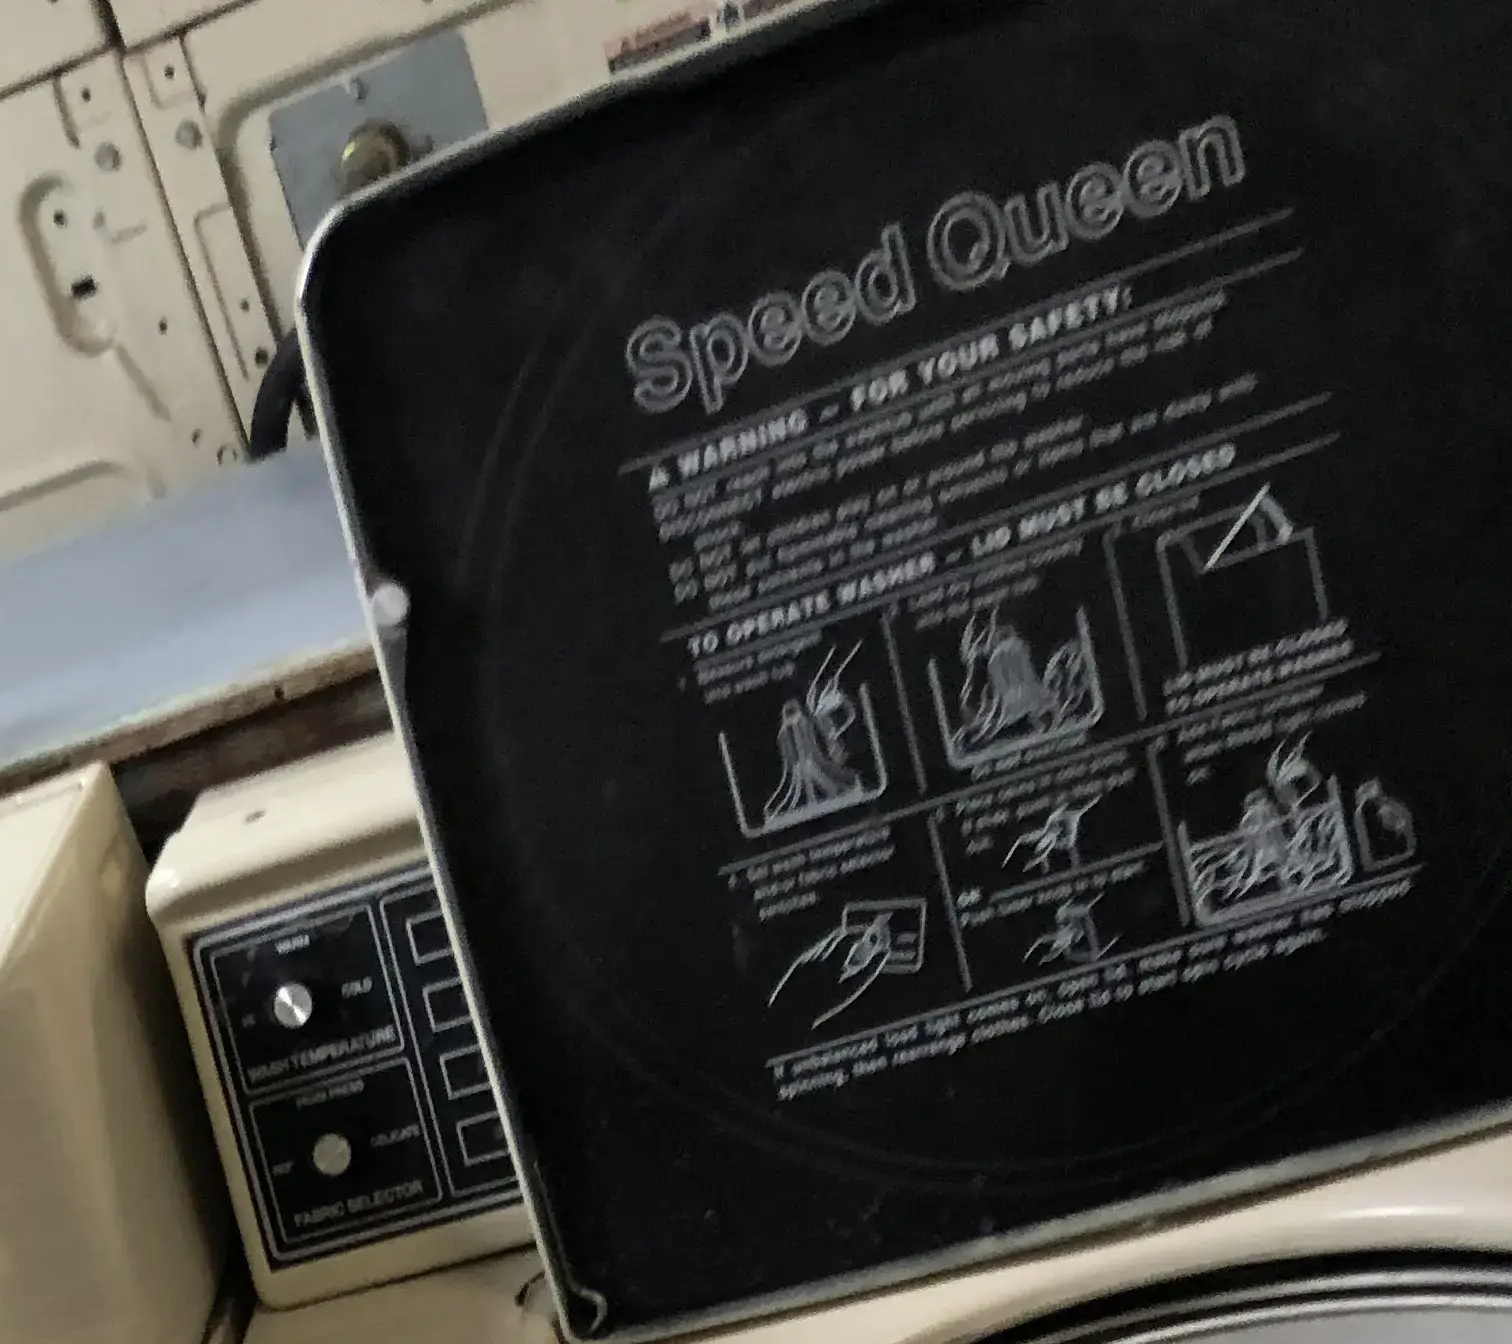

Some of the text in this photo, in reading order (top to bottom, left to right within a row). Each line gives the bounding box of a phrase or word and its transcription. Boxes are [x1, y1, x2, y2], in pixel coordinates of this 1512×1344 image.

[625, 222, 917, 412] Speed
[926, 113, 1247, 295] Queen
[675, 407, 809, 480] WARNING
[848, 368, 910, 414] FOR
[916, 333, 1000, 388] YOUR
[686, 629, 721, 662] TO
[723, 589, 831, 649] OPERATE
[834, 550, 937, 609] WASHER
[969, 522, 1014, 560] LID
[1093, 480, 1129, 516] BE
